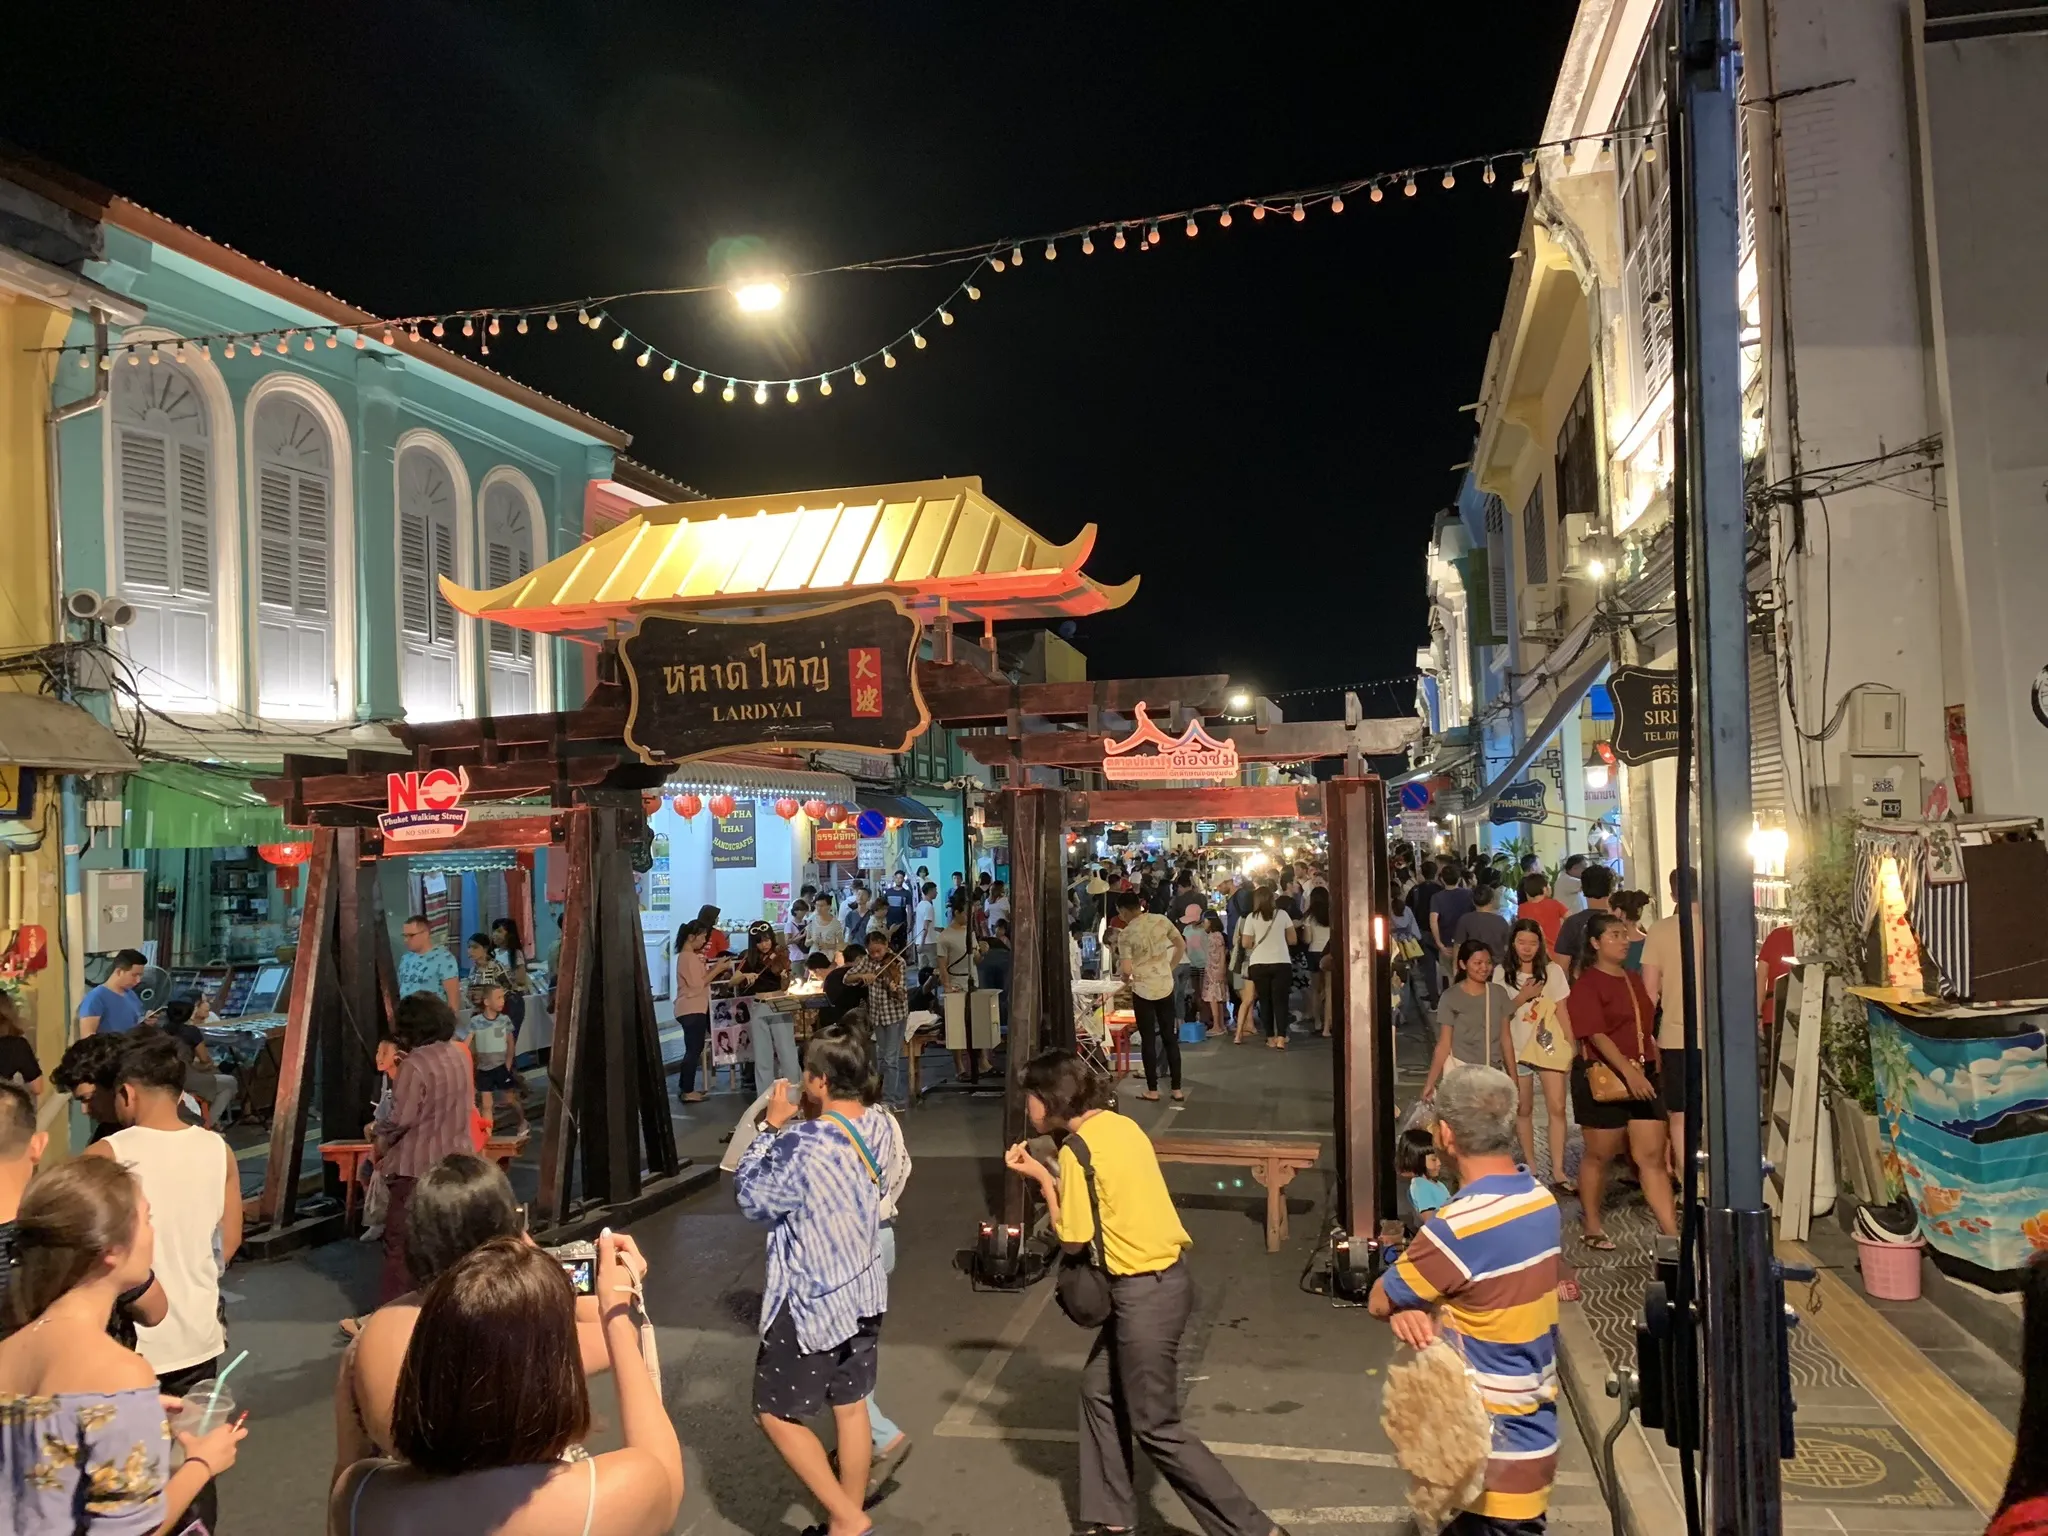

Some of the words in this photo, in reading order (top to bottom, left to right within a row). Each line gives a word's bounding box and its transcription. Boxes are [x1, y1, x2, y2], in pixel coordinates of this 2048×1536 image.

[712, 701, 803, 722] LARDYAI
[1644, 710, 1678, 726] SIRI
[1643, 730, 1679, 742] TEL.07
[1173, 750, 1235, 766] ต้องชม
[388, 770, 460, 812] NO
[384, 816, 408, 826] Phuket
[410, 813, 440, 822] Walking
[441, 812, 463, 820] Street
[721, 825, 744, 833] THAI
[713, 836, 754, 851] HANDICRAFTS
